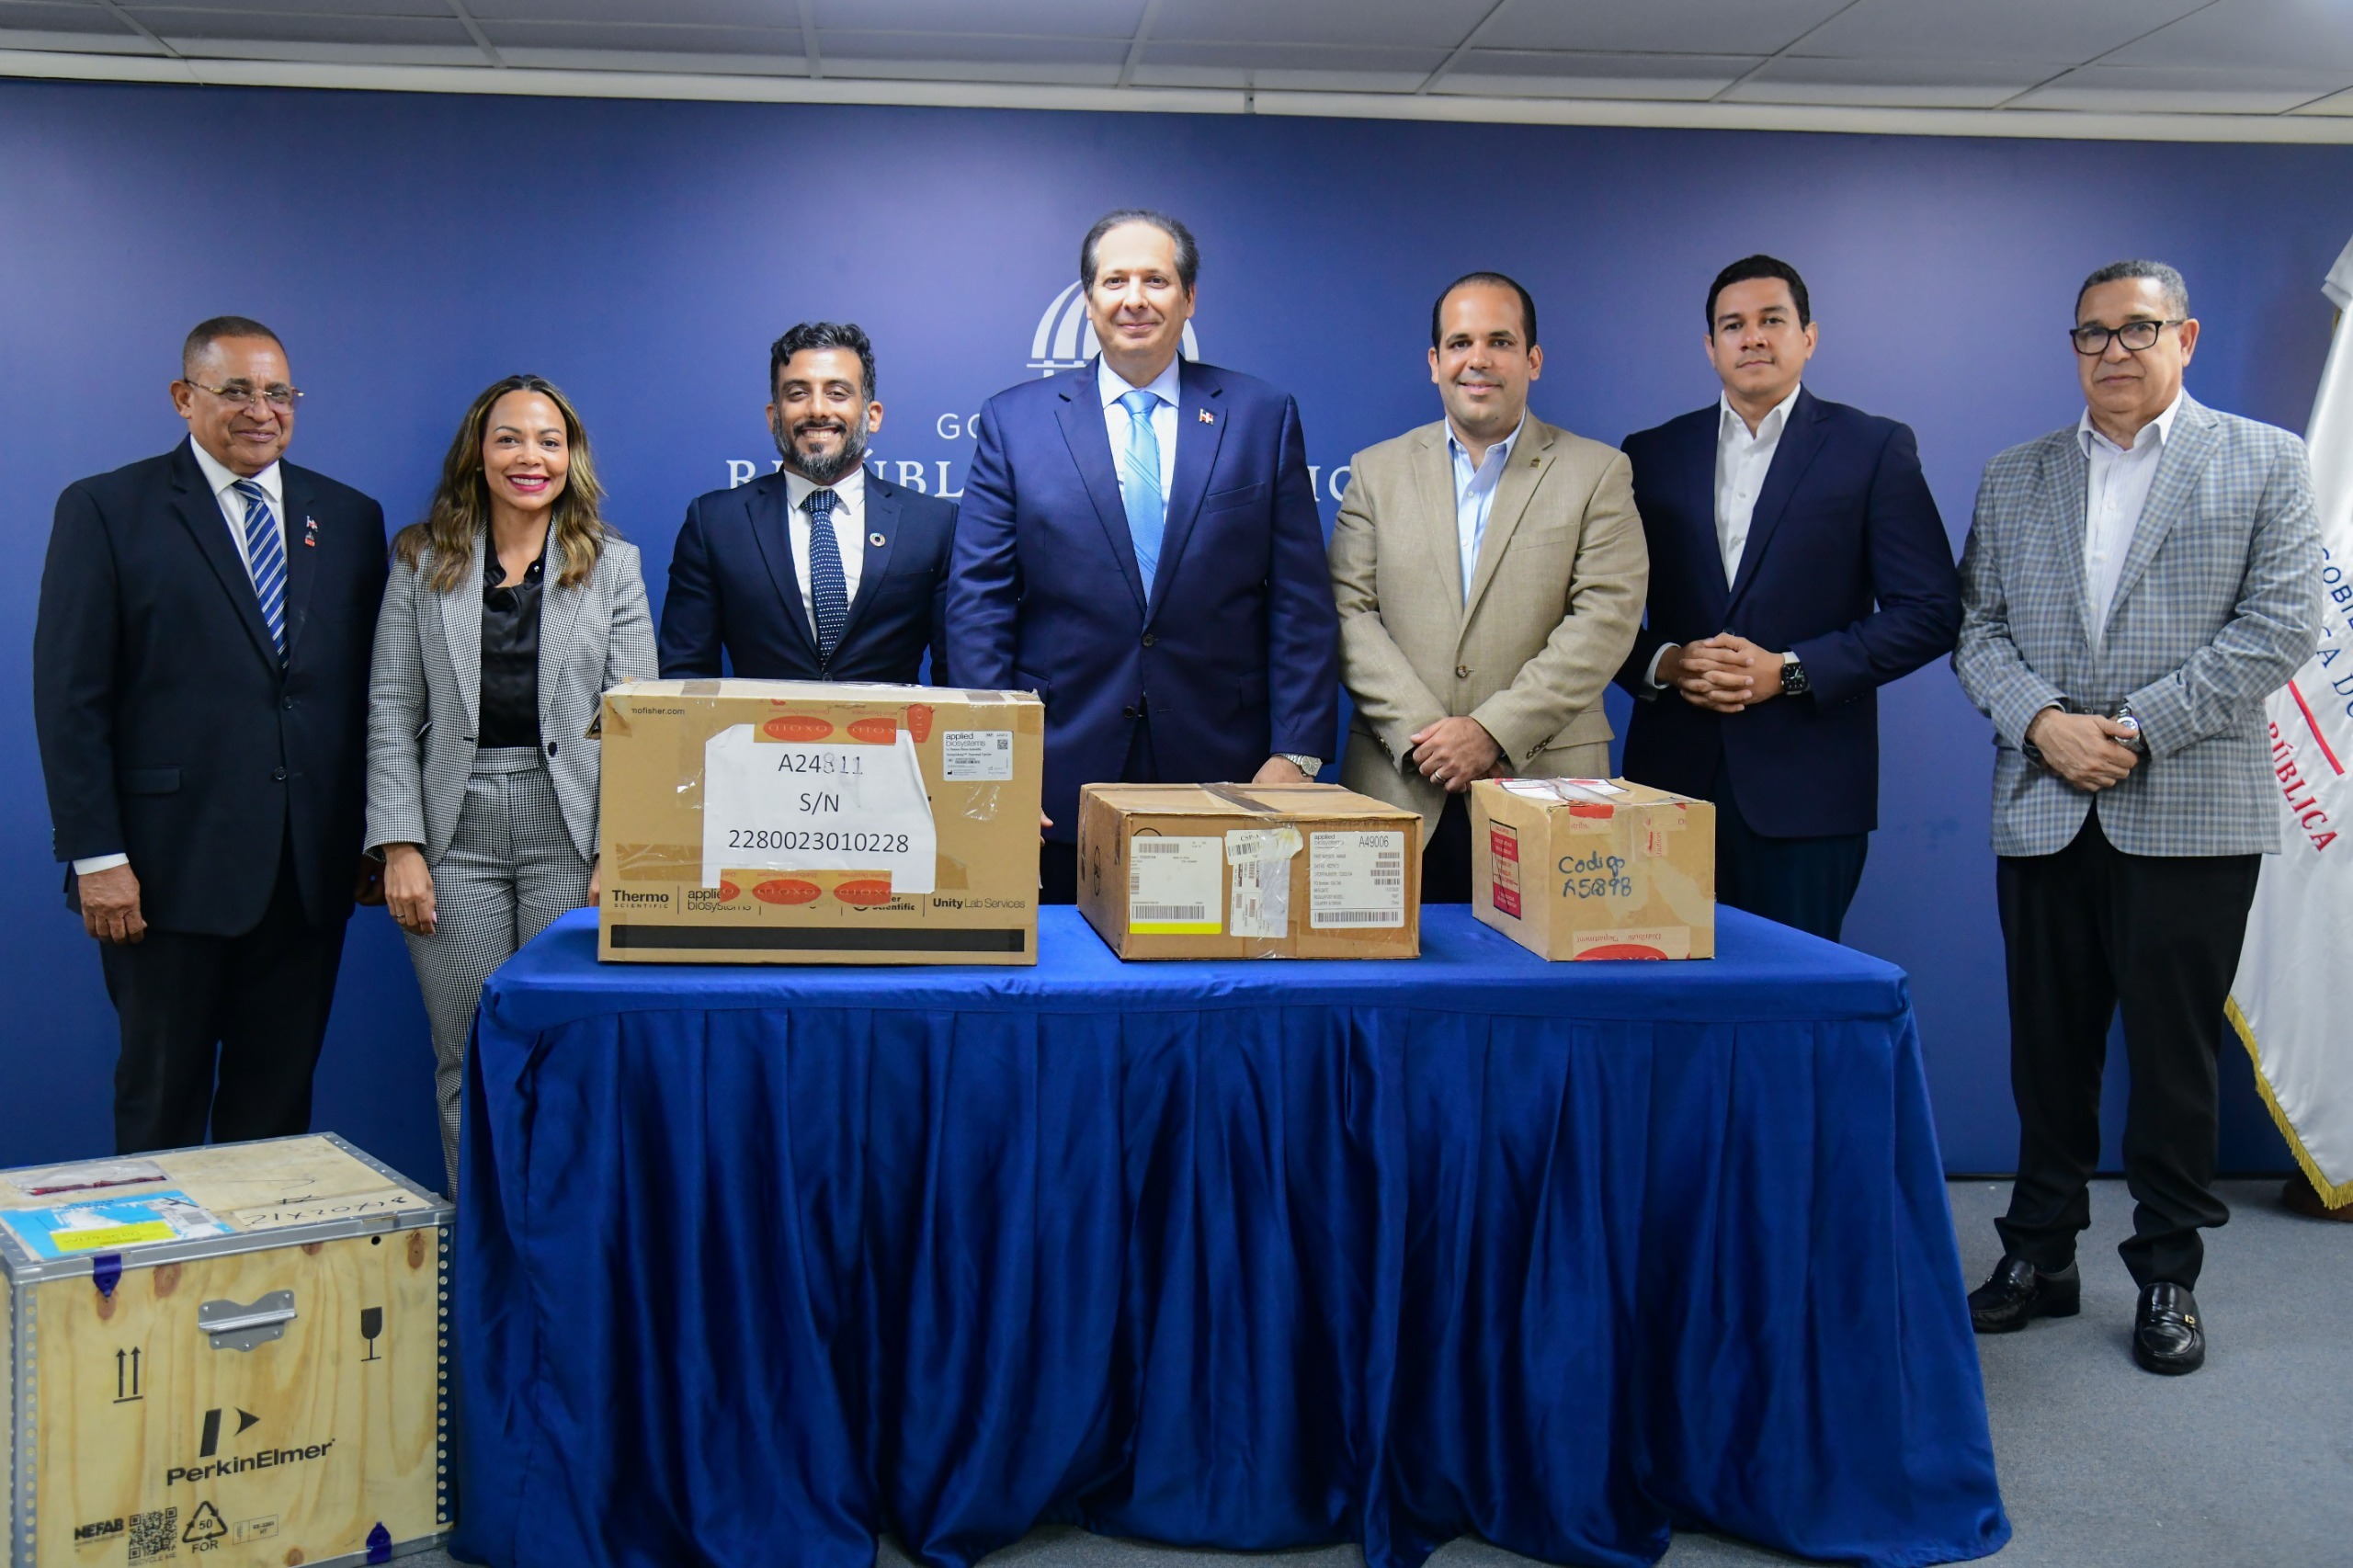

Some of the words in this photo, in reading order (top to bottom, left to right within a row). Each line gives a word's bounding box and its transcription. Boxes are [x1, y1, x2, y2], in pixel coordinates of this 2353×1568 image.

[946, 733, 974, 741] applied
[779, 753, 863, 775] A24811
[2268, 720, 2338, 852] PÚBLICA
[800, 791, 839, 815] S/N
[728, 829, 909, 853] 2280023010228
[1358, 835, 1389, 847] A49006
[612, 889, 669, 903] Thermo
[688, 889, 721, 901] applie
[933, 897, 963, 909] Unity
[964, 898, 983, 908] Lab
[984, 898, 1026, 909] Services
[166, 1440, 333, 1486] PerkinElmer
[74, 1517, 124, 1540] NEFAB
[199, 1518, 213, 1530] 50
[191, 1540, 219, 1553] FOR
